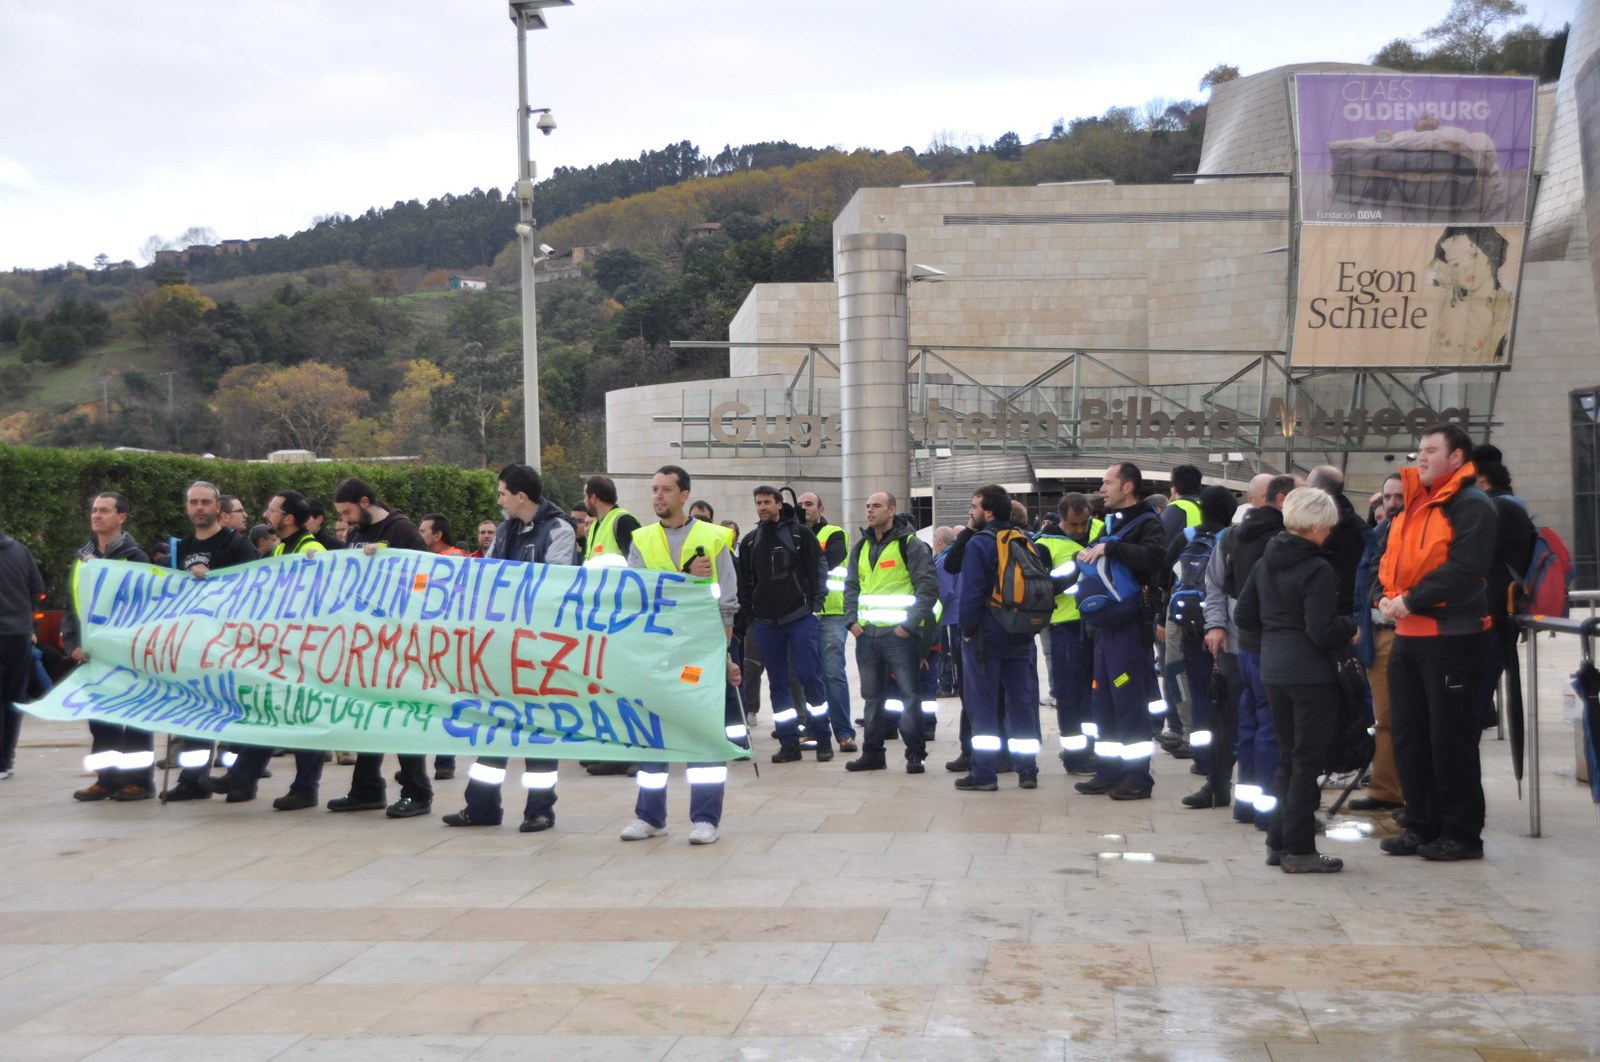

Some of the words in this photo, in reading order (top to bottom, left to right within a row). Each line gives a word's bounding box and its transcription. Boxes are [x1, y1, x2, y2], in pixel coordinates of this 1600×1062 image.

[1342, 79, 1413, 101] CLAES
[1342, 100, 1491, 121] OLDENBURG
[1316, 210, 1356, 220] Fundación
[1357, 210, 1382, 220] BBVA
[1336, 261, 1417, 304] Egon
[1308, 296, 1428, 330] Schiele
[1079, 396, 1239, 440] Bilbao
[420, 556, 549, 626] BATEN
[554, 566, 687, 636] ALDE
